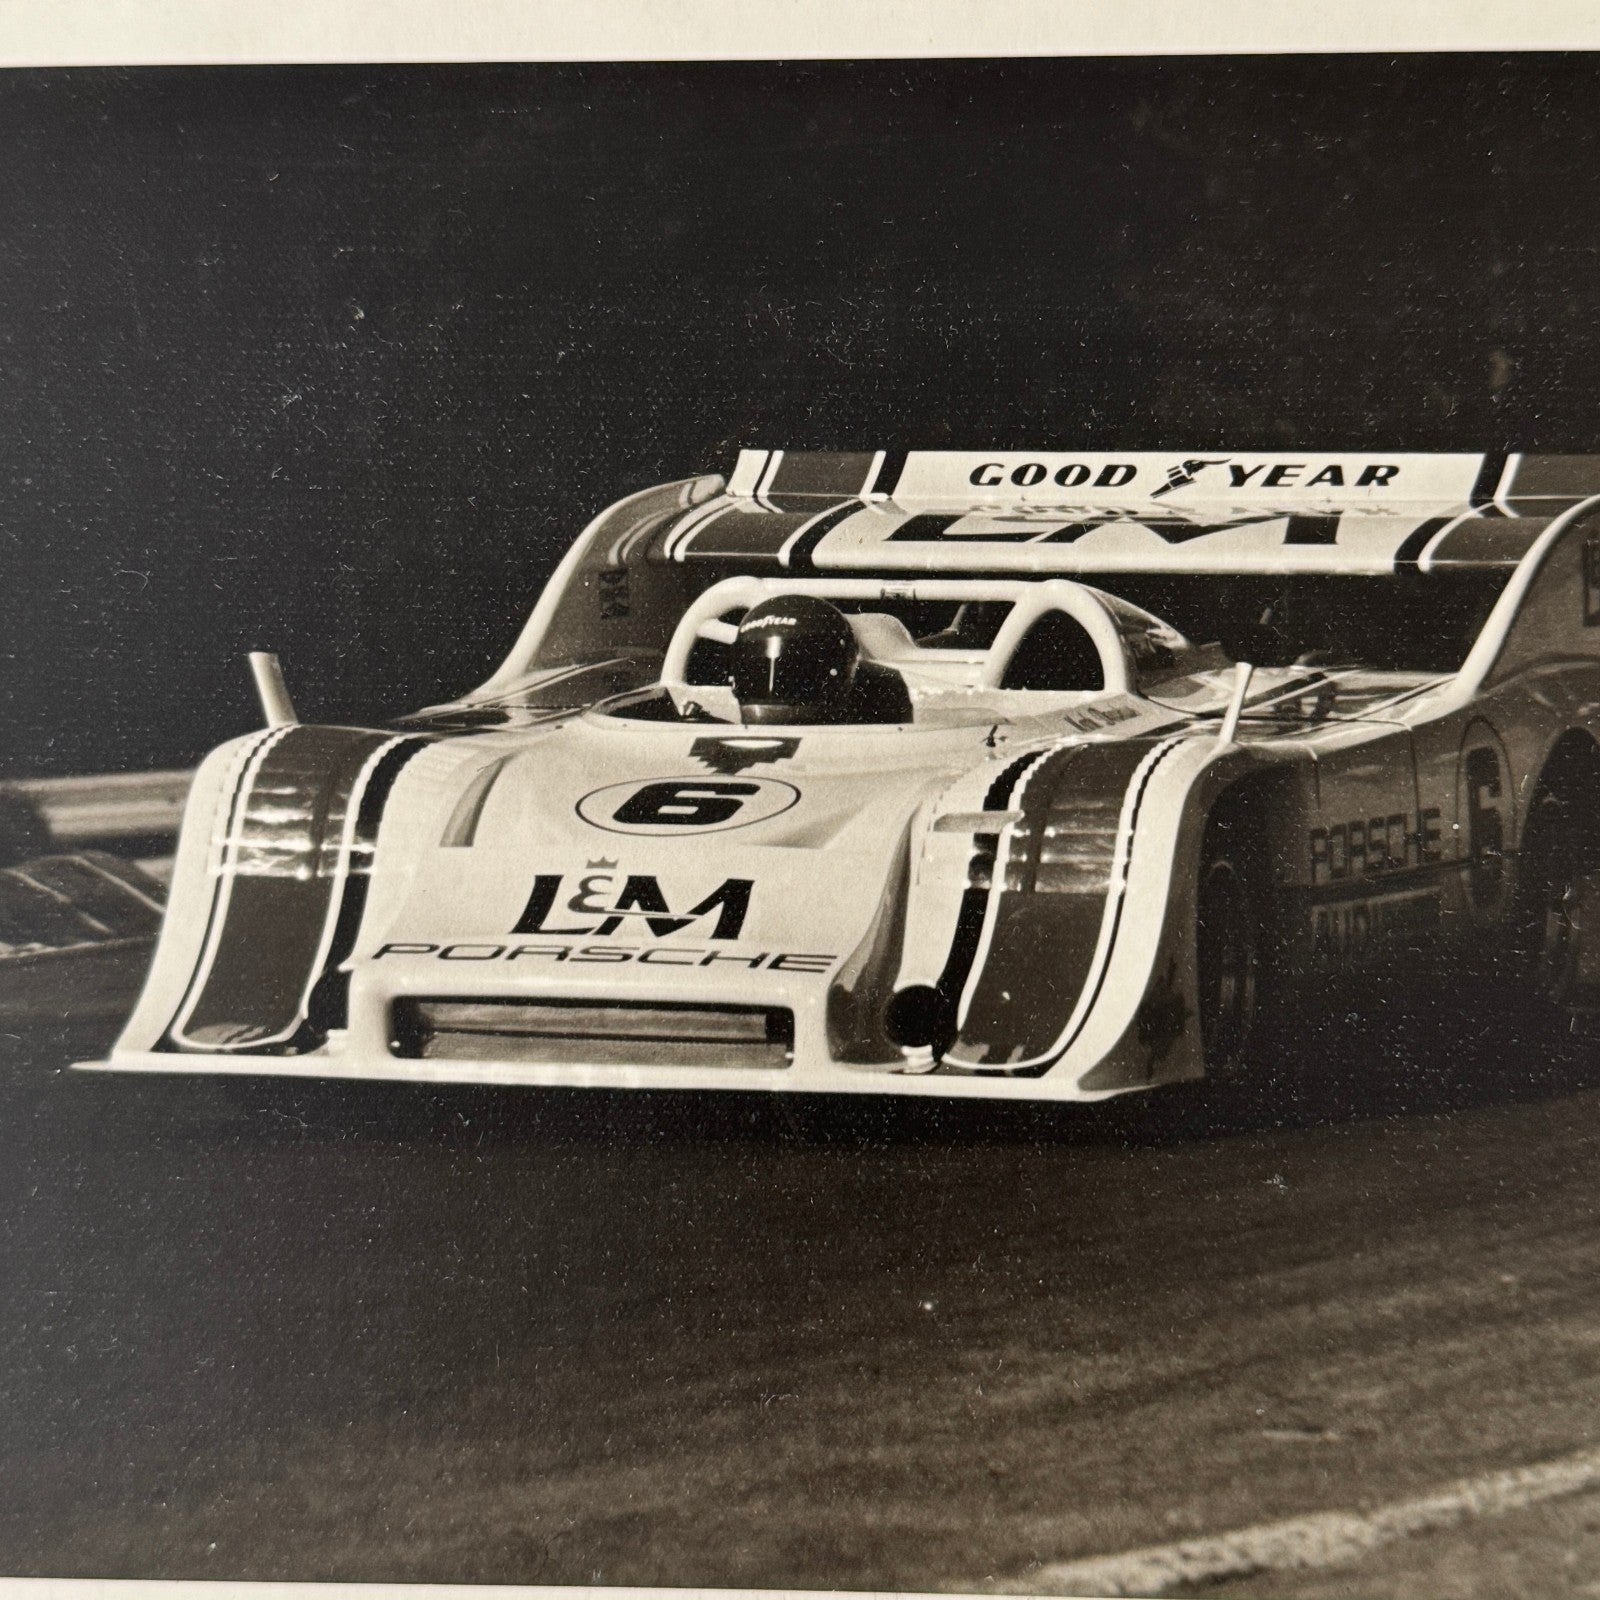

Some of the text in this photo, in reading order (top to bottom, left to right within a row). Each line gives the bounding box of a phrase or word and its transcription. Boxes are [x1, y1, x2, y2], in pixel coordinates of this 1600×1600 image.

[969, 463, 1400, 488] GOOD YEAR
[612, 782, 760, 825] 6
[371, 942, 838, 974] PORSCHE
